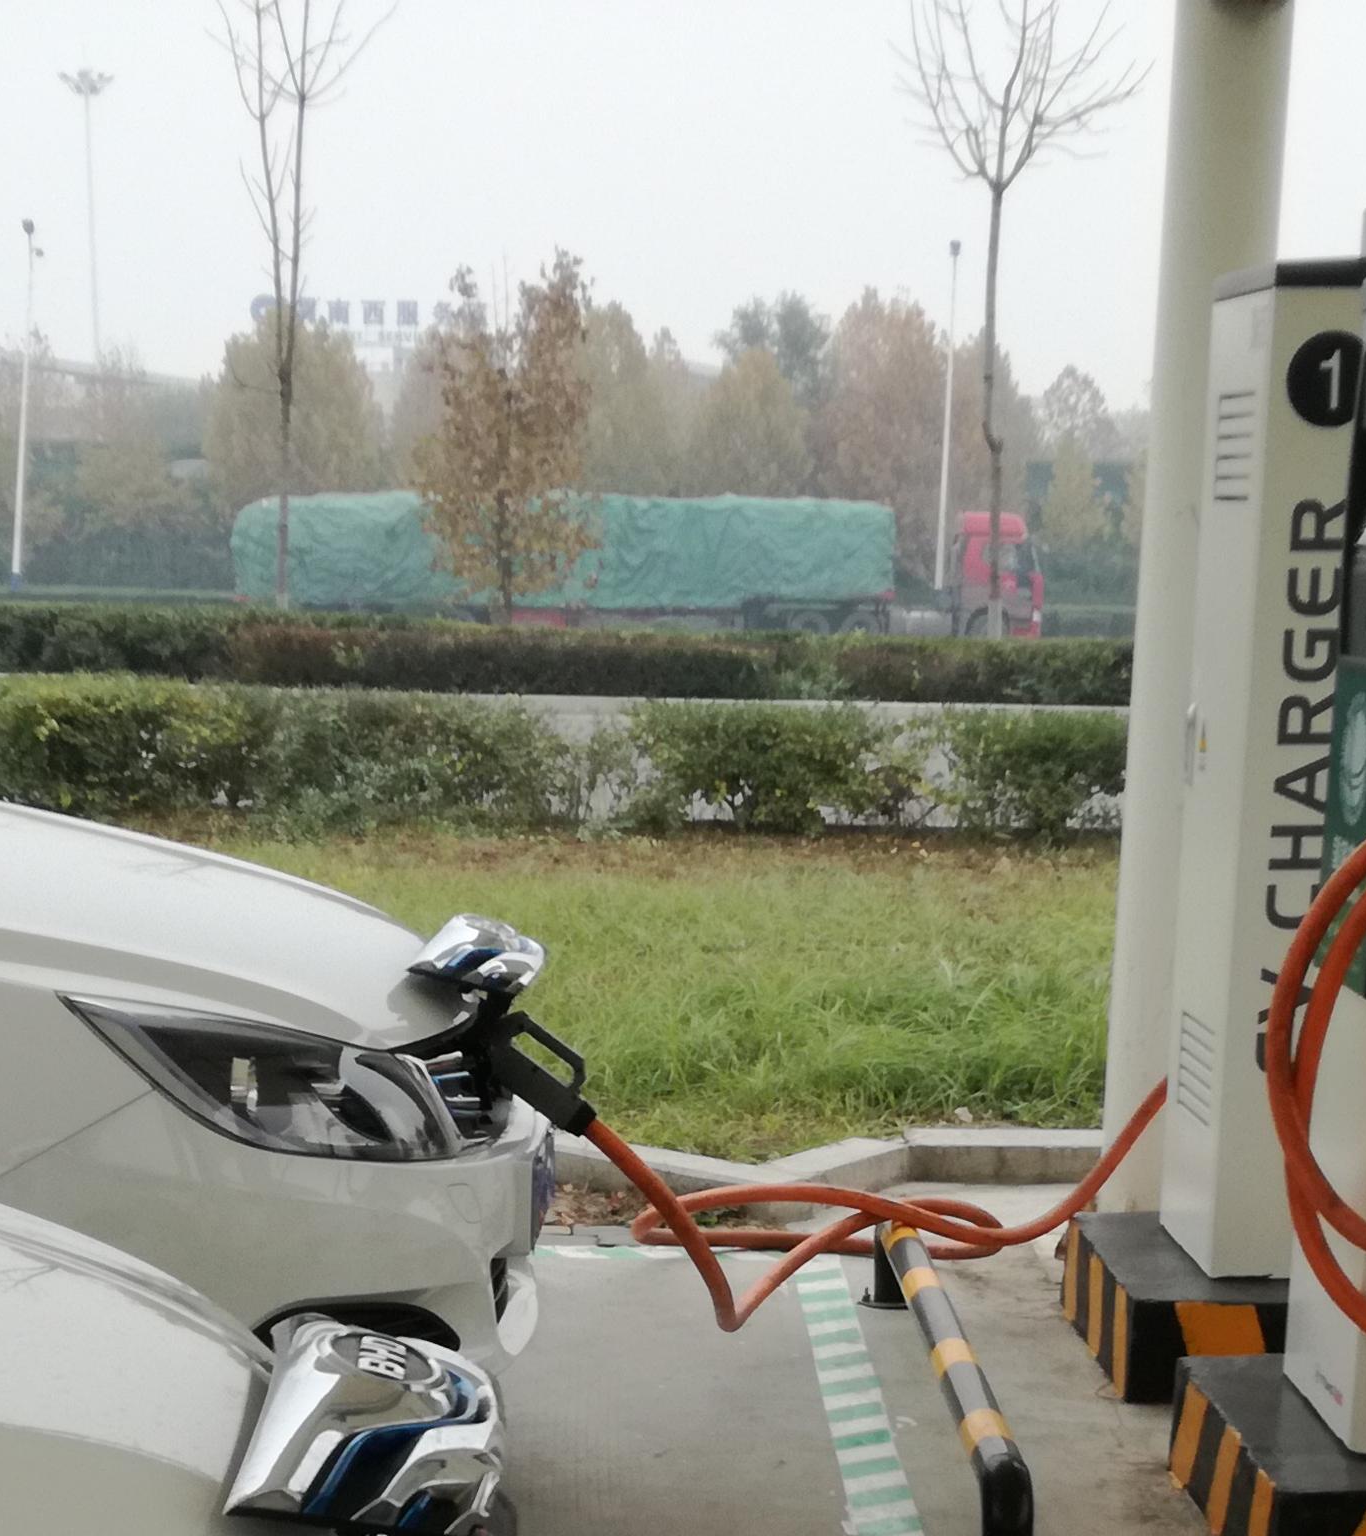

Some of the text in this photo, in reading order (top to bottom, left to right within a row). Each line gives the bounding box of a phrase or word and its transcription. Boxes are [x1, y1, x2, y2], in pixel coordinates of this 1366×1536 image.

[1319, 348, 1341, 410] 1
[1266, 497, 1347, 931] CHARGER
[357, 1335, 407, 1380] BYD
